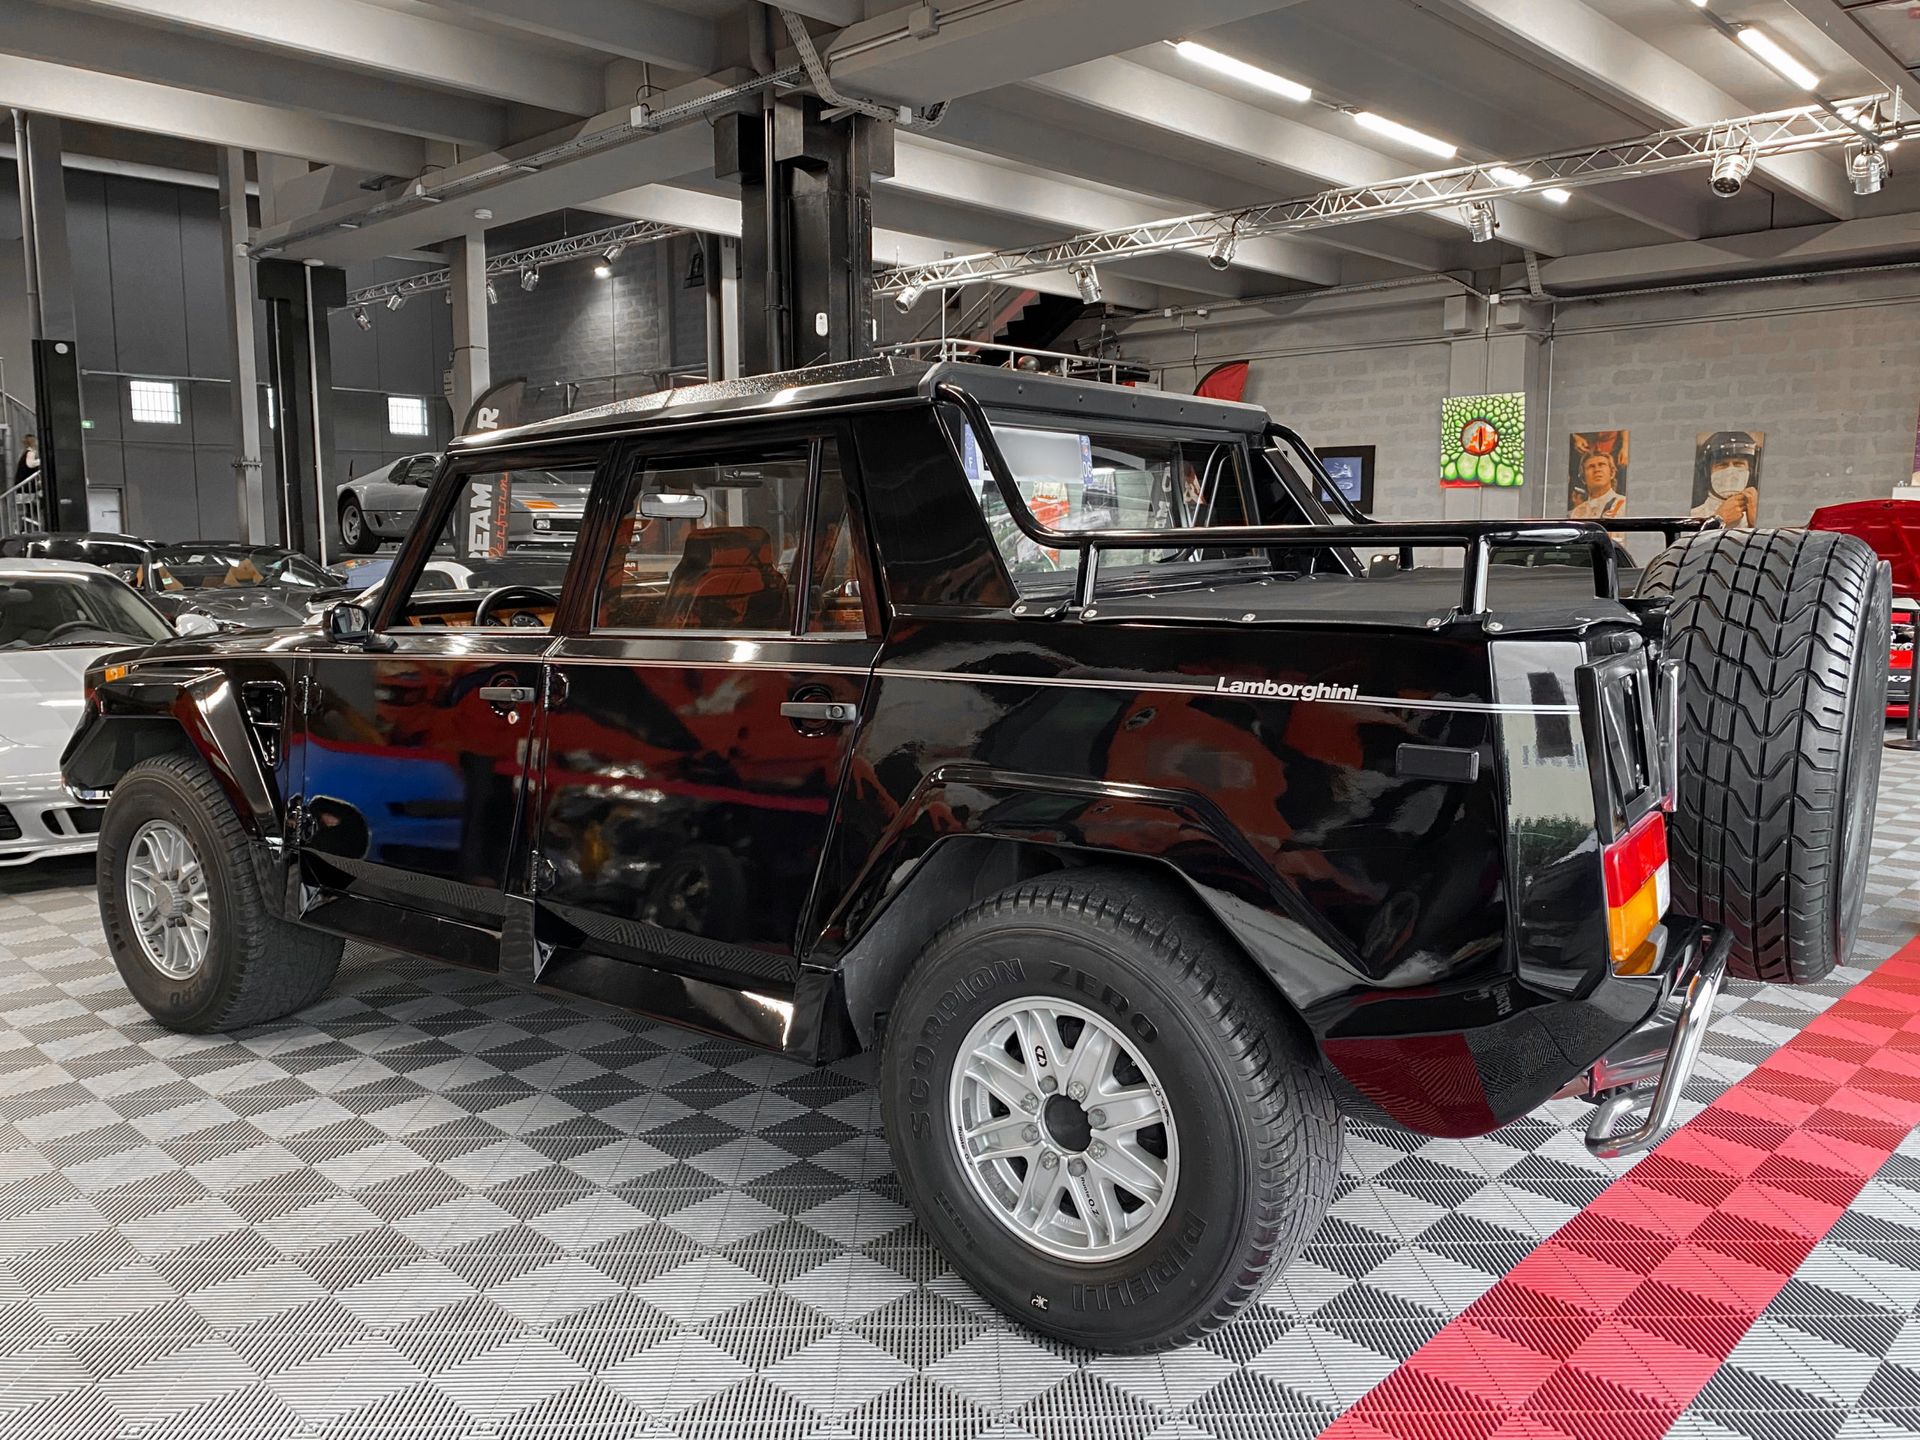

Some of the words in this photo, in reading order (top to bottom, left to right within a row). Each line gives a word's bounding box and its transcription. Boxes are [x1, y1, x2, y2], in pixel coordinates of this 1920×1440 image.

[1216, 676, 1359, 702] Lamborghini
[908, 958, 1026, 1141] SCORPION
[1049, 960, 1159, 1043] ZERO
[1072, 1208, 1208, 1312] PIRELLI
